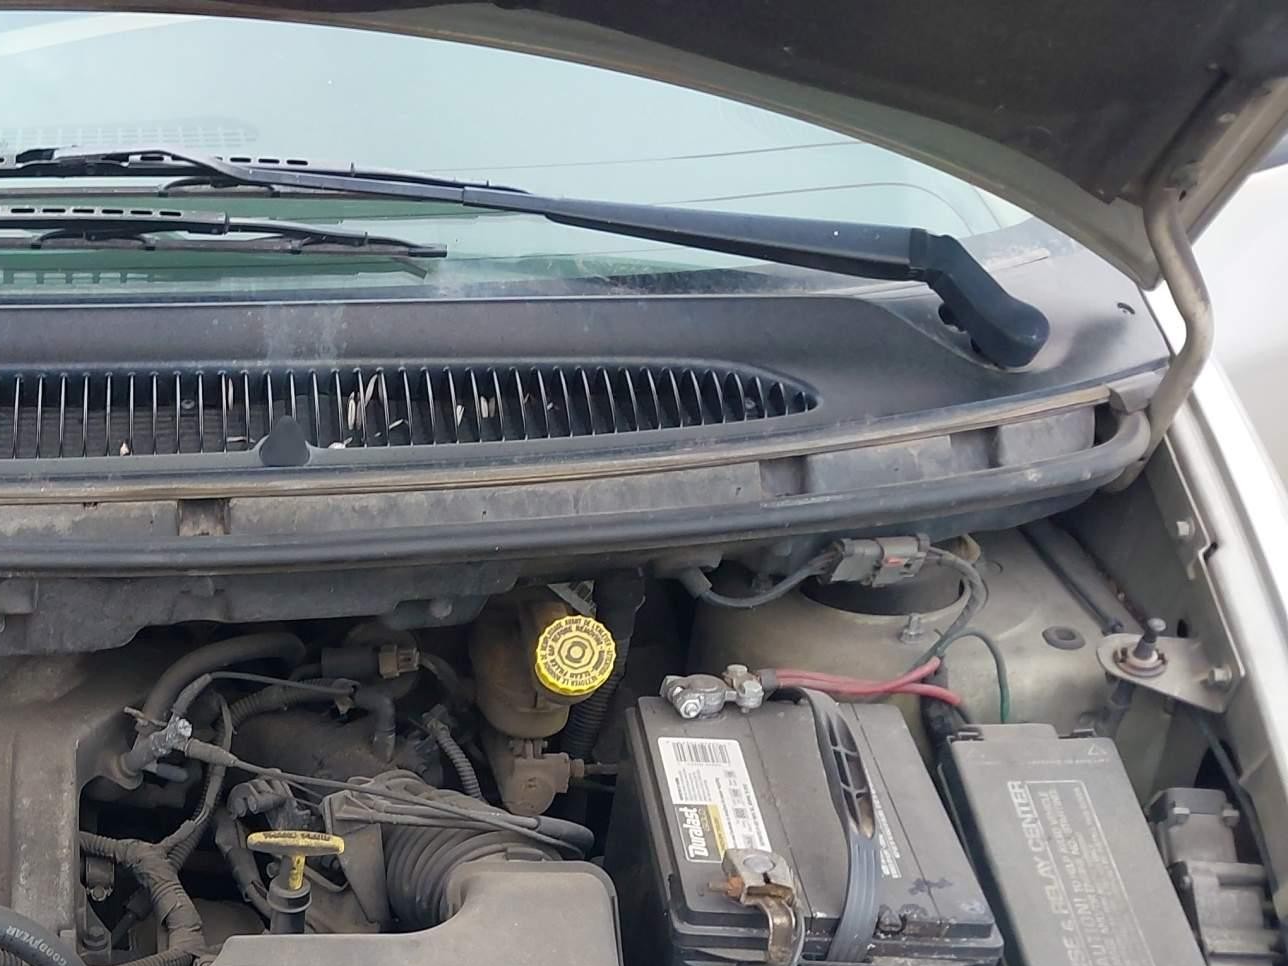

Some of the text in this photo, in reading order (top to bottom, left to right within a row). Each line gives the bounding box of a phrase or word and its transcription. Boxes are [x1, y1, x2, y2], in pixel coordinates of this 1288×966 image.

[679, 806, 709, 858] Duralast
[1007, 780, 1045, 853] CENTER
[1034, 856, 1069, 915] RELAY
[6, 925, 67, 966] GOODYEAR
